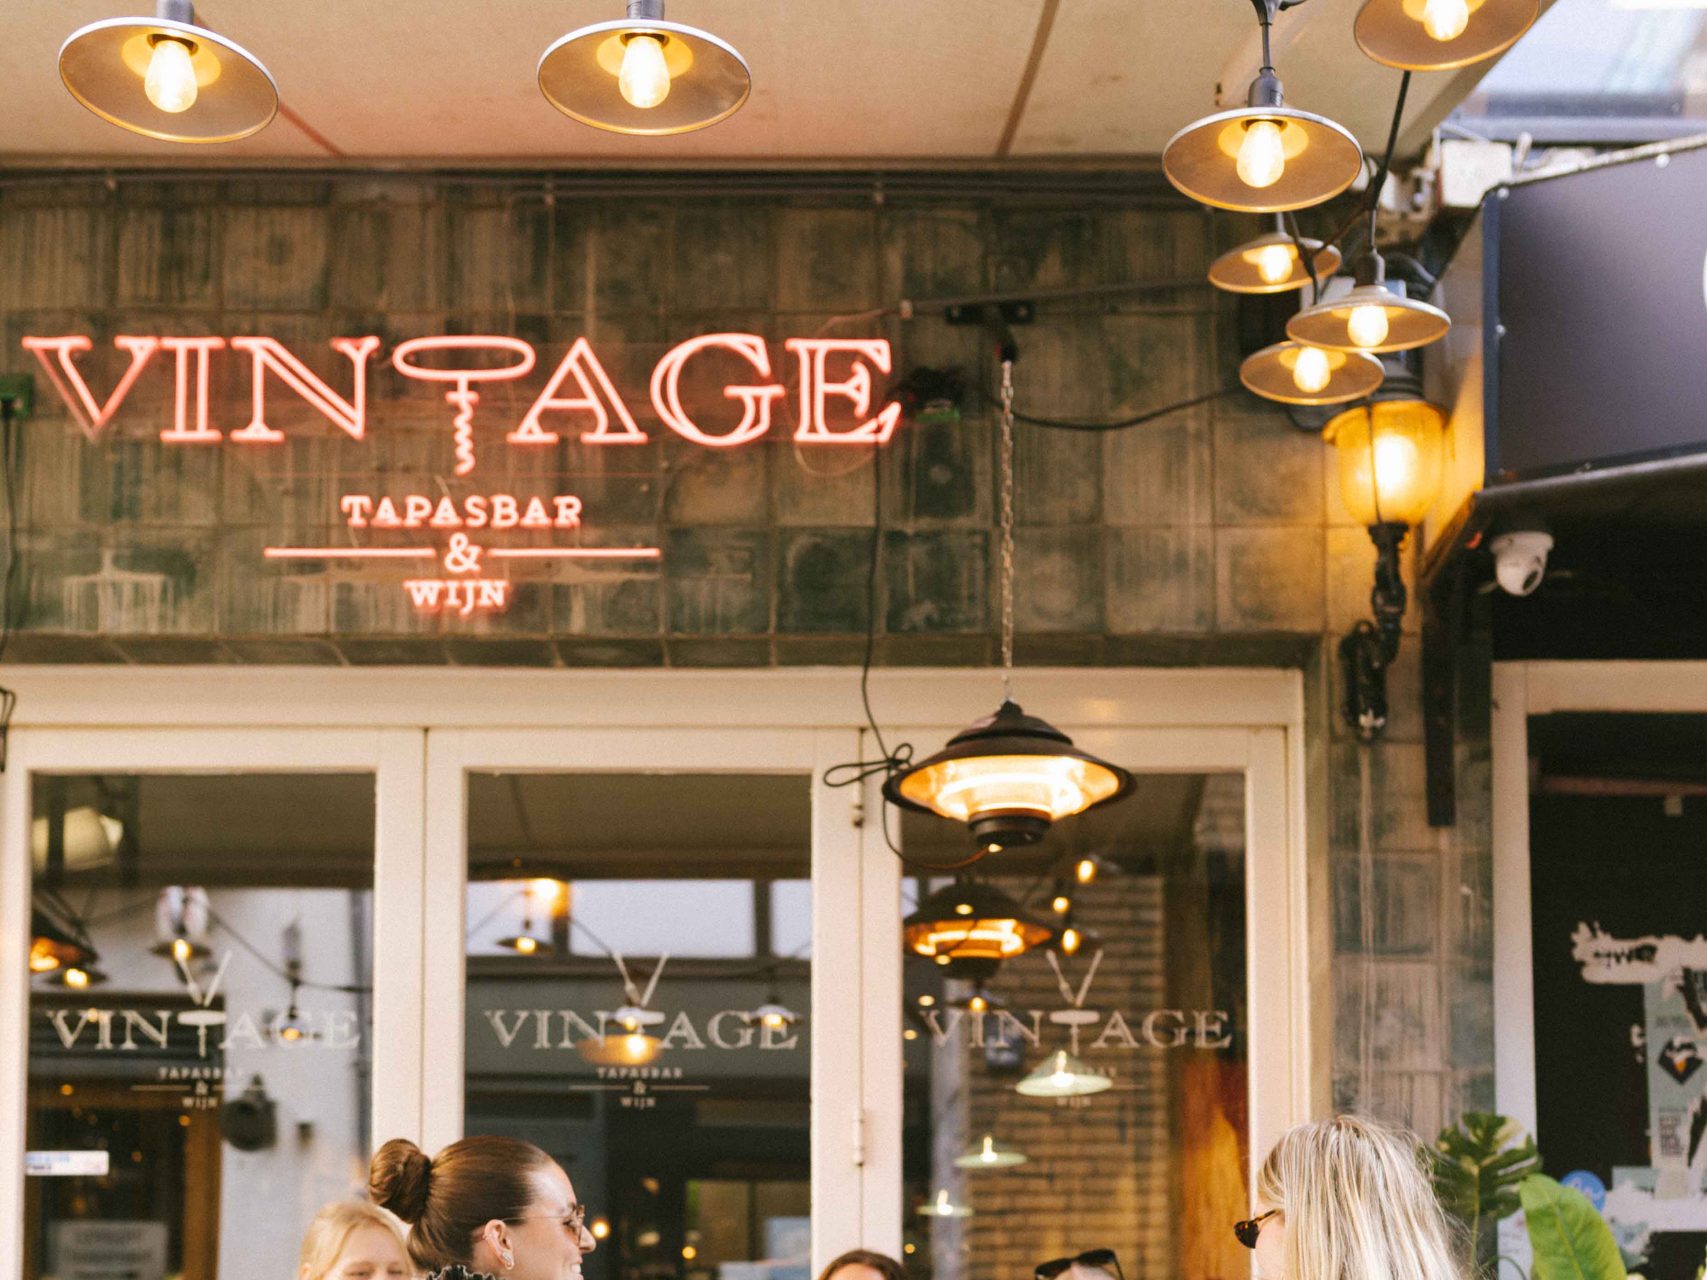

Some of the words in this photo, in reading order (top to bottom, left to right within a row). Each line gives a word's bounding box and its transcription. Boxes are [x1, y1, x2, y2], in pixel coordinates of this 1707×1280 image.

[22, 333, 902, 476] VINTAGE
[341, 495, 583, 528] TAPASBAR
[444, 532, 482, 573] &
[403, 579, 511, 616] WIJN
[919, 1010, 1232, 1056] VINTAGE
